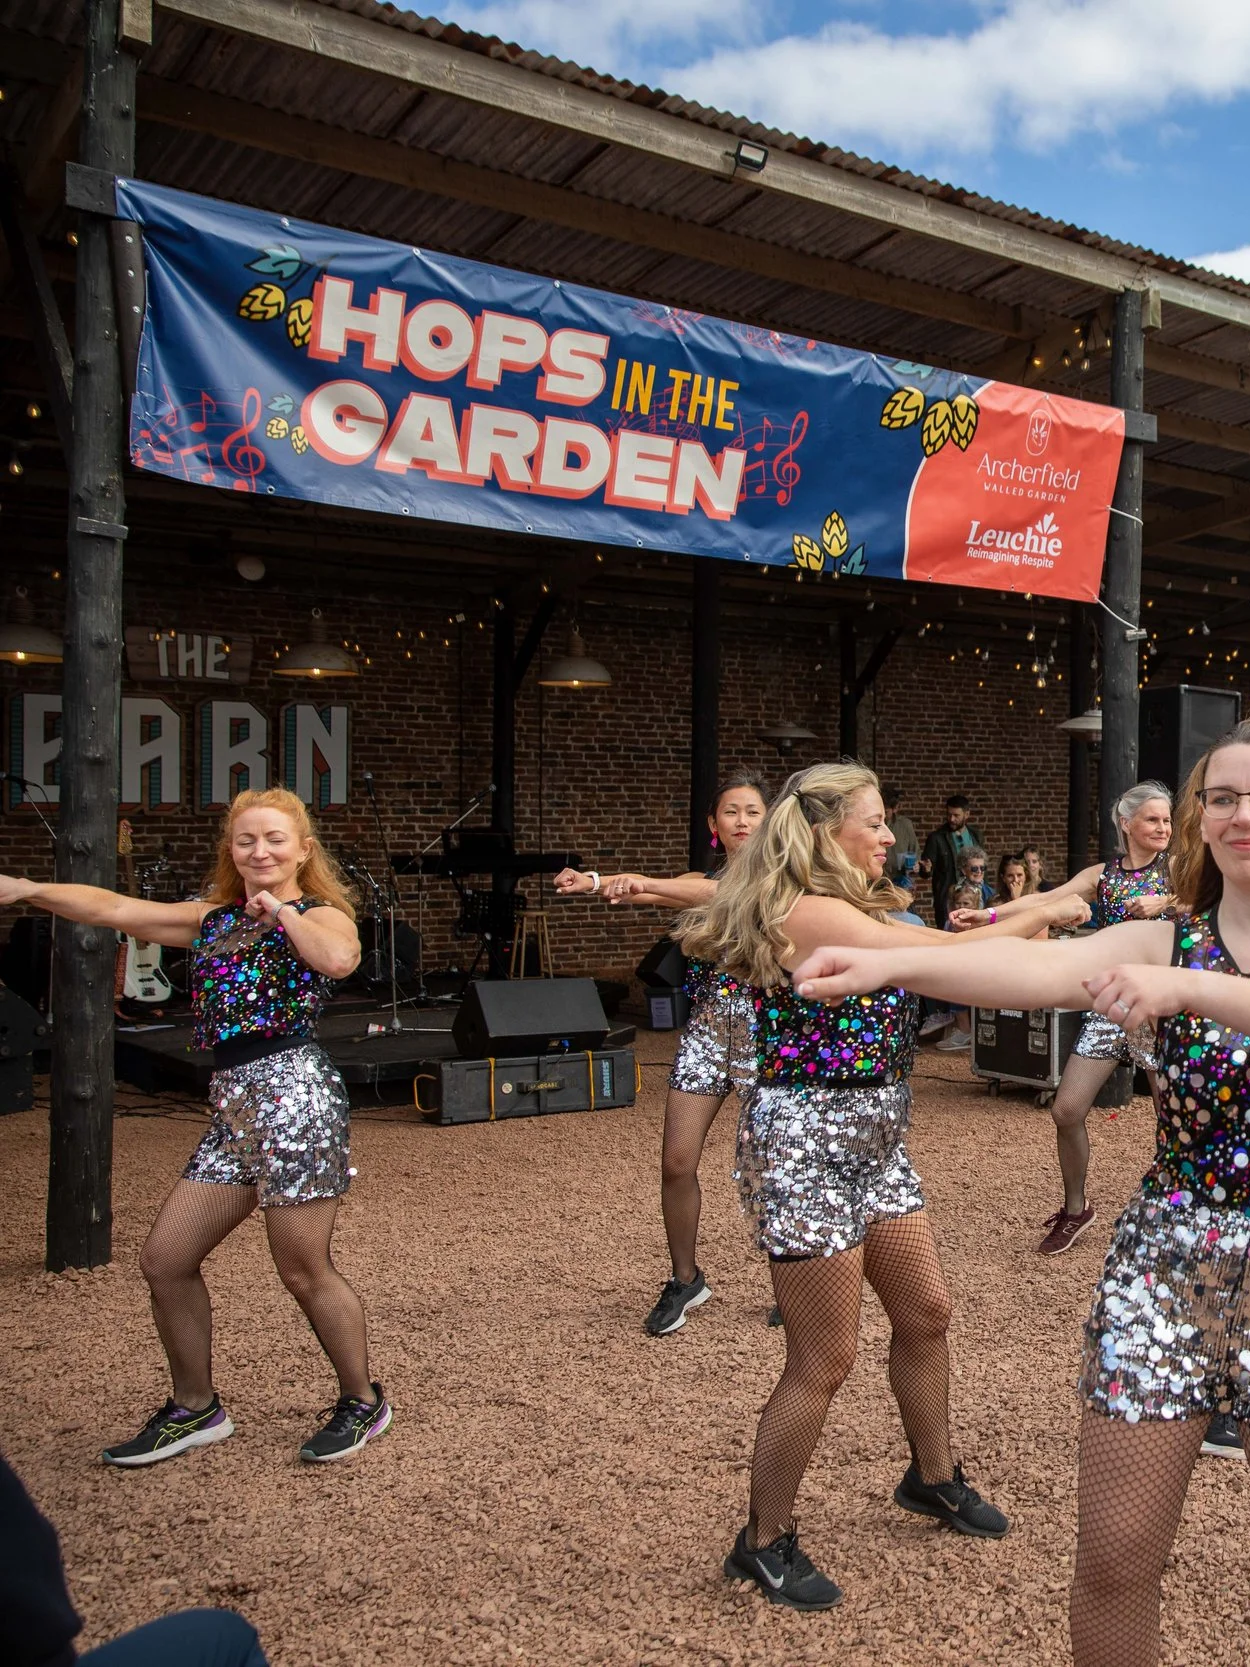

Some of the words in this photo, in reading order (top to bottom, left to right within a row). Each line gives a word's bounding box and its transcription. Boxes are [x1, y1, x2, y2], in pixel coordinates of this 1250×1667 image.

[307, 273, 611, 406] HOPS
[611, 358, 662, 415] IN
[669, 367, 741, 432] THE
[300, 379, 746, 521] GARDEN
[976, 452, 1081, 491] Archerfield
[983, 482, 1025, 498] WALLED
[1027, 489, 1067, 504] GARDEN
[965, 519, 1063, 558] Leuchie
[966, 546, 1020, 567] Reimagining
[1021, 554, 1055, 569] Respite
[150, 632, 231, 680] THE
[10, 692, 350, 812] BARN
[1000, 1009, 1023, 1018] SHURE
